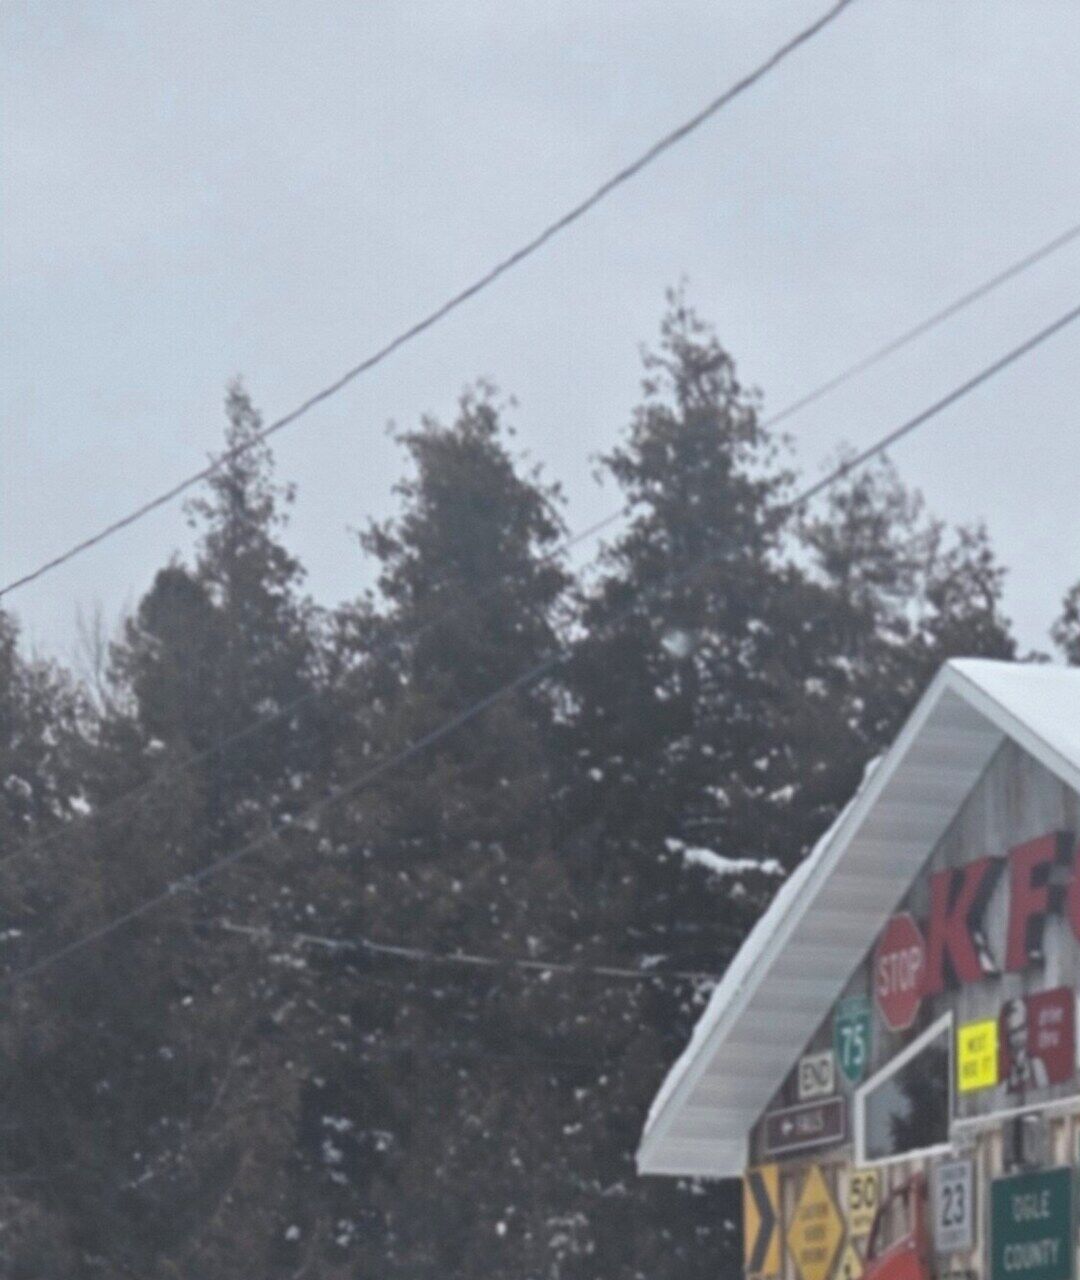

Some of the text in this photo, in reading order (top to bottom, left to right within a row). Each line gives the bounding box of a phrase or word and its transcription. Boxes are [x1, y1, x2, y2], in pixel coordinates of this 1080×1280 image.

[878, 946, 924, 997] STOP
[841, 1023, 865, 1067] 75
[802, 1058, 832, 1093] END
[941, 1182, 965, 1227] 23
[1003, 1239, 1061, 1271] COUNTY
